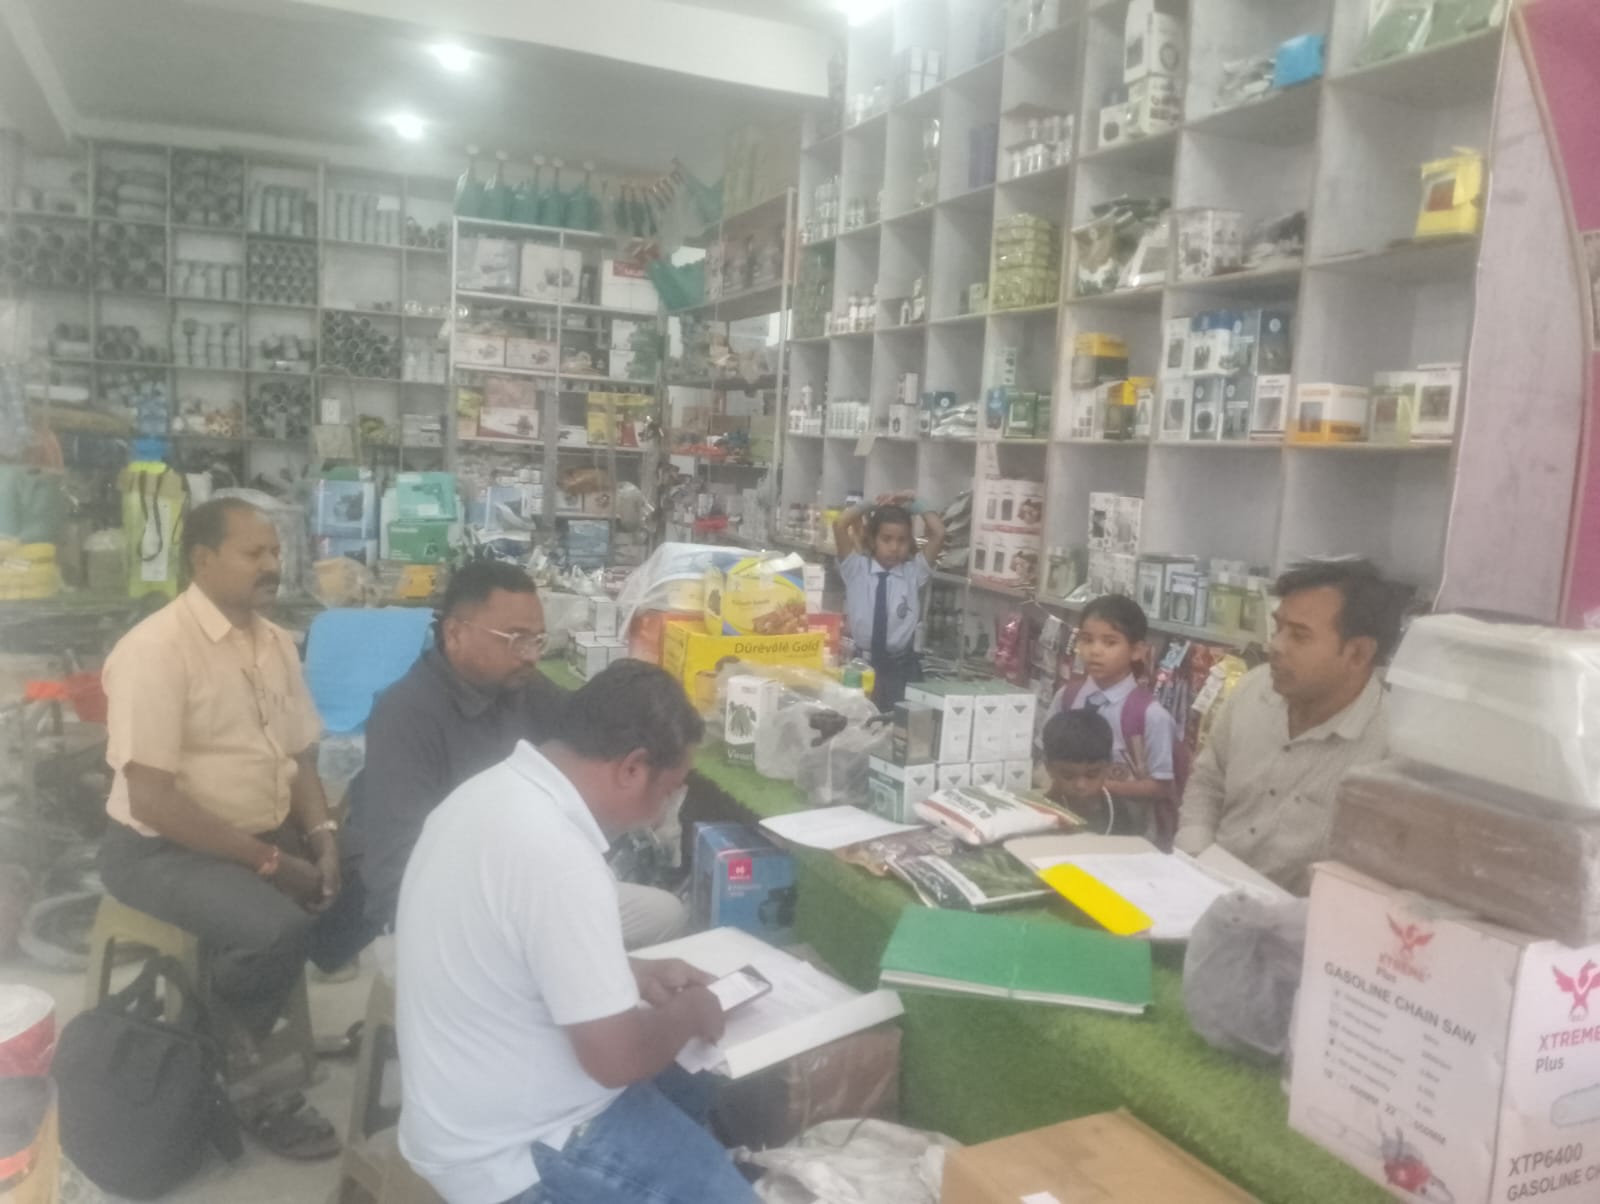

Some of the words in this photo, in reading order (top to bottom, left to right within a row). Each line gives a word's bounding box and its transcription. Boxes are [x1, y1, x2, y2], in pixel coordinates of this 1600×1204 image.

[792, 638, 820, 654] Gold
[1323, 961, 1392, 1005] GASOLINE
[1394, 994, 1440, 1028] CHAIN
[1441, 1017, 1477, 1046] SAW
[1535, 1055, 1565, 1074] Plus
[1508, 1142, 1584, 1178] XTP6400
[1507, 1167, 1583, 1202] GASOLINE
